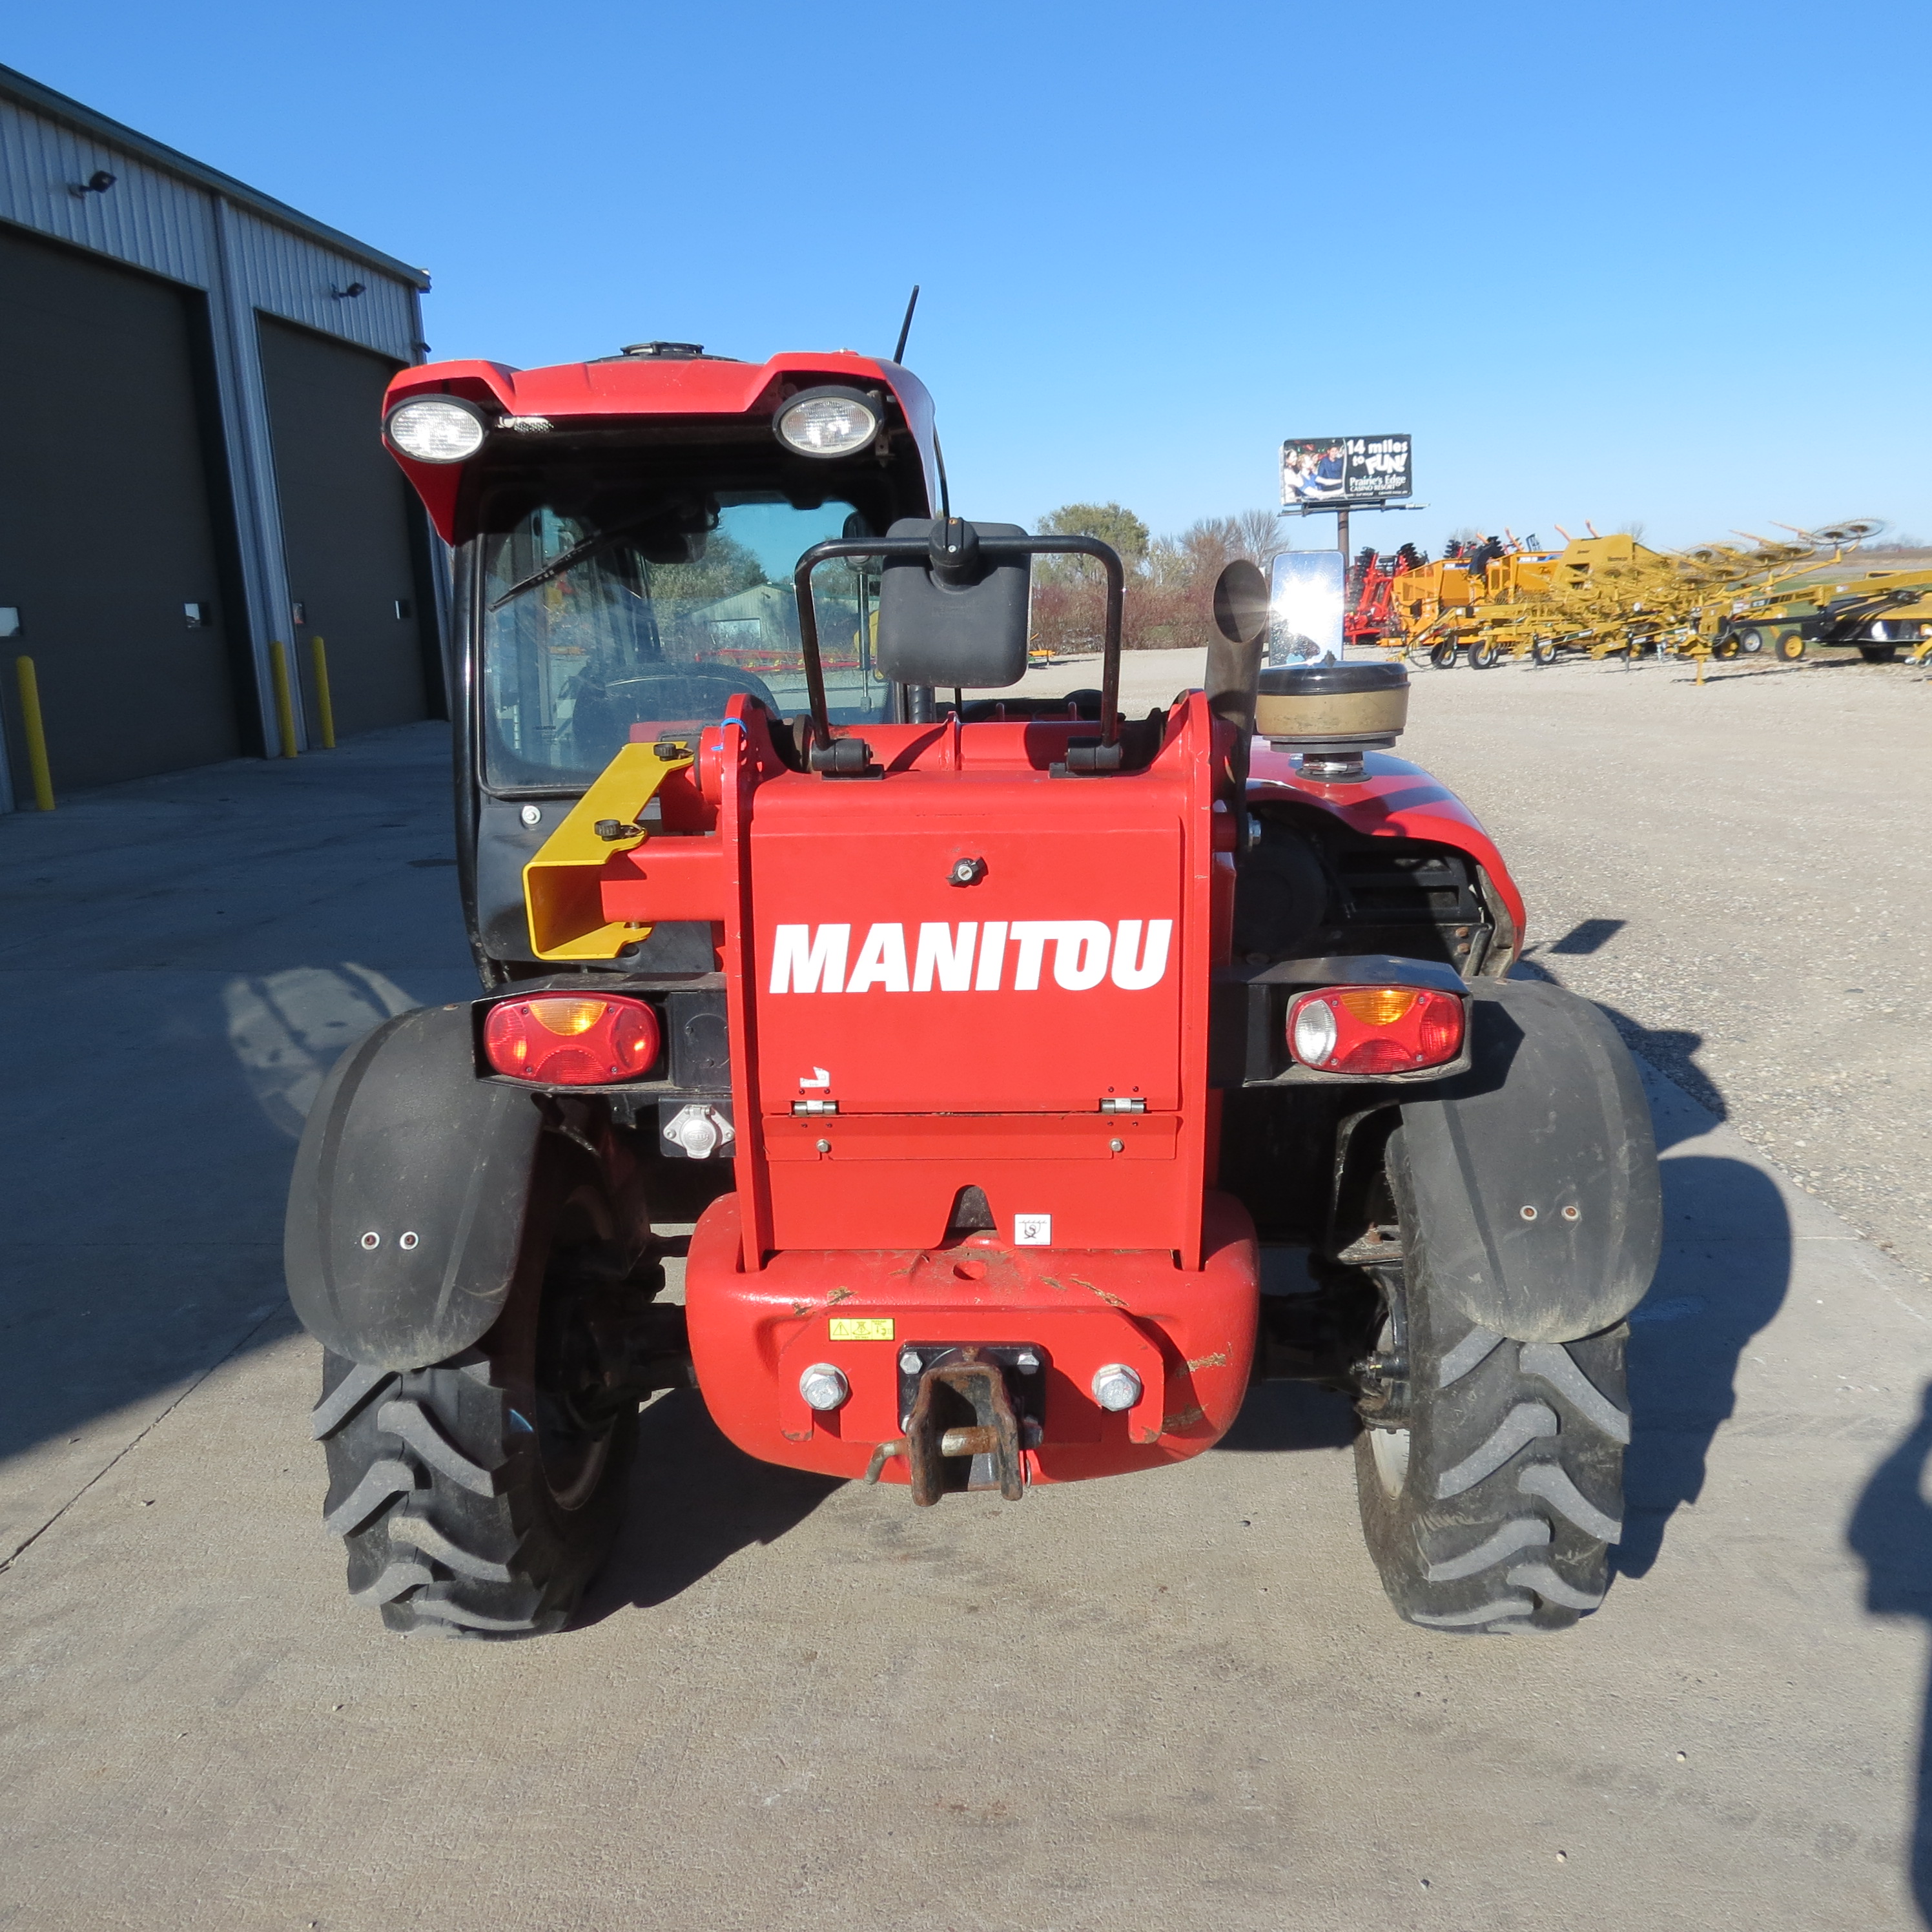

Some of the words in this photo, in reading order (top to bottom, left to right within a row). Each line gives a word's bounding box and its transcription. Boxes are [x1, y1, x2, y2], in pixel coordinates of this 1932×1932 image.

[1347, 439, 1366, 455] 14
[1368, 439, 1408, 453] miles
[1352, 455, 1365, 467] to
[1365, 453, 1408, 475] FUN!
[1384, 473, 1406, 487] Edge
[769, 919, 1173, 994] MANITOU
